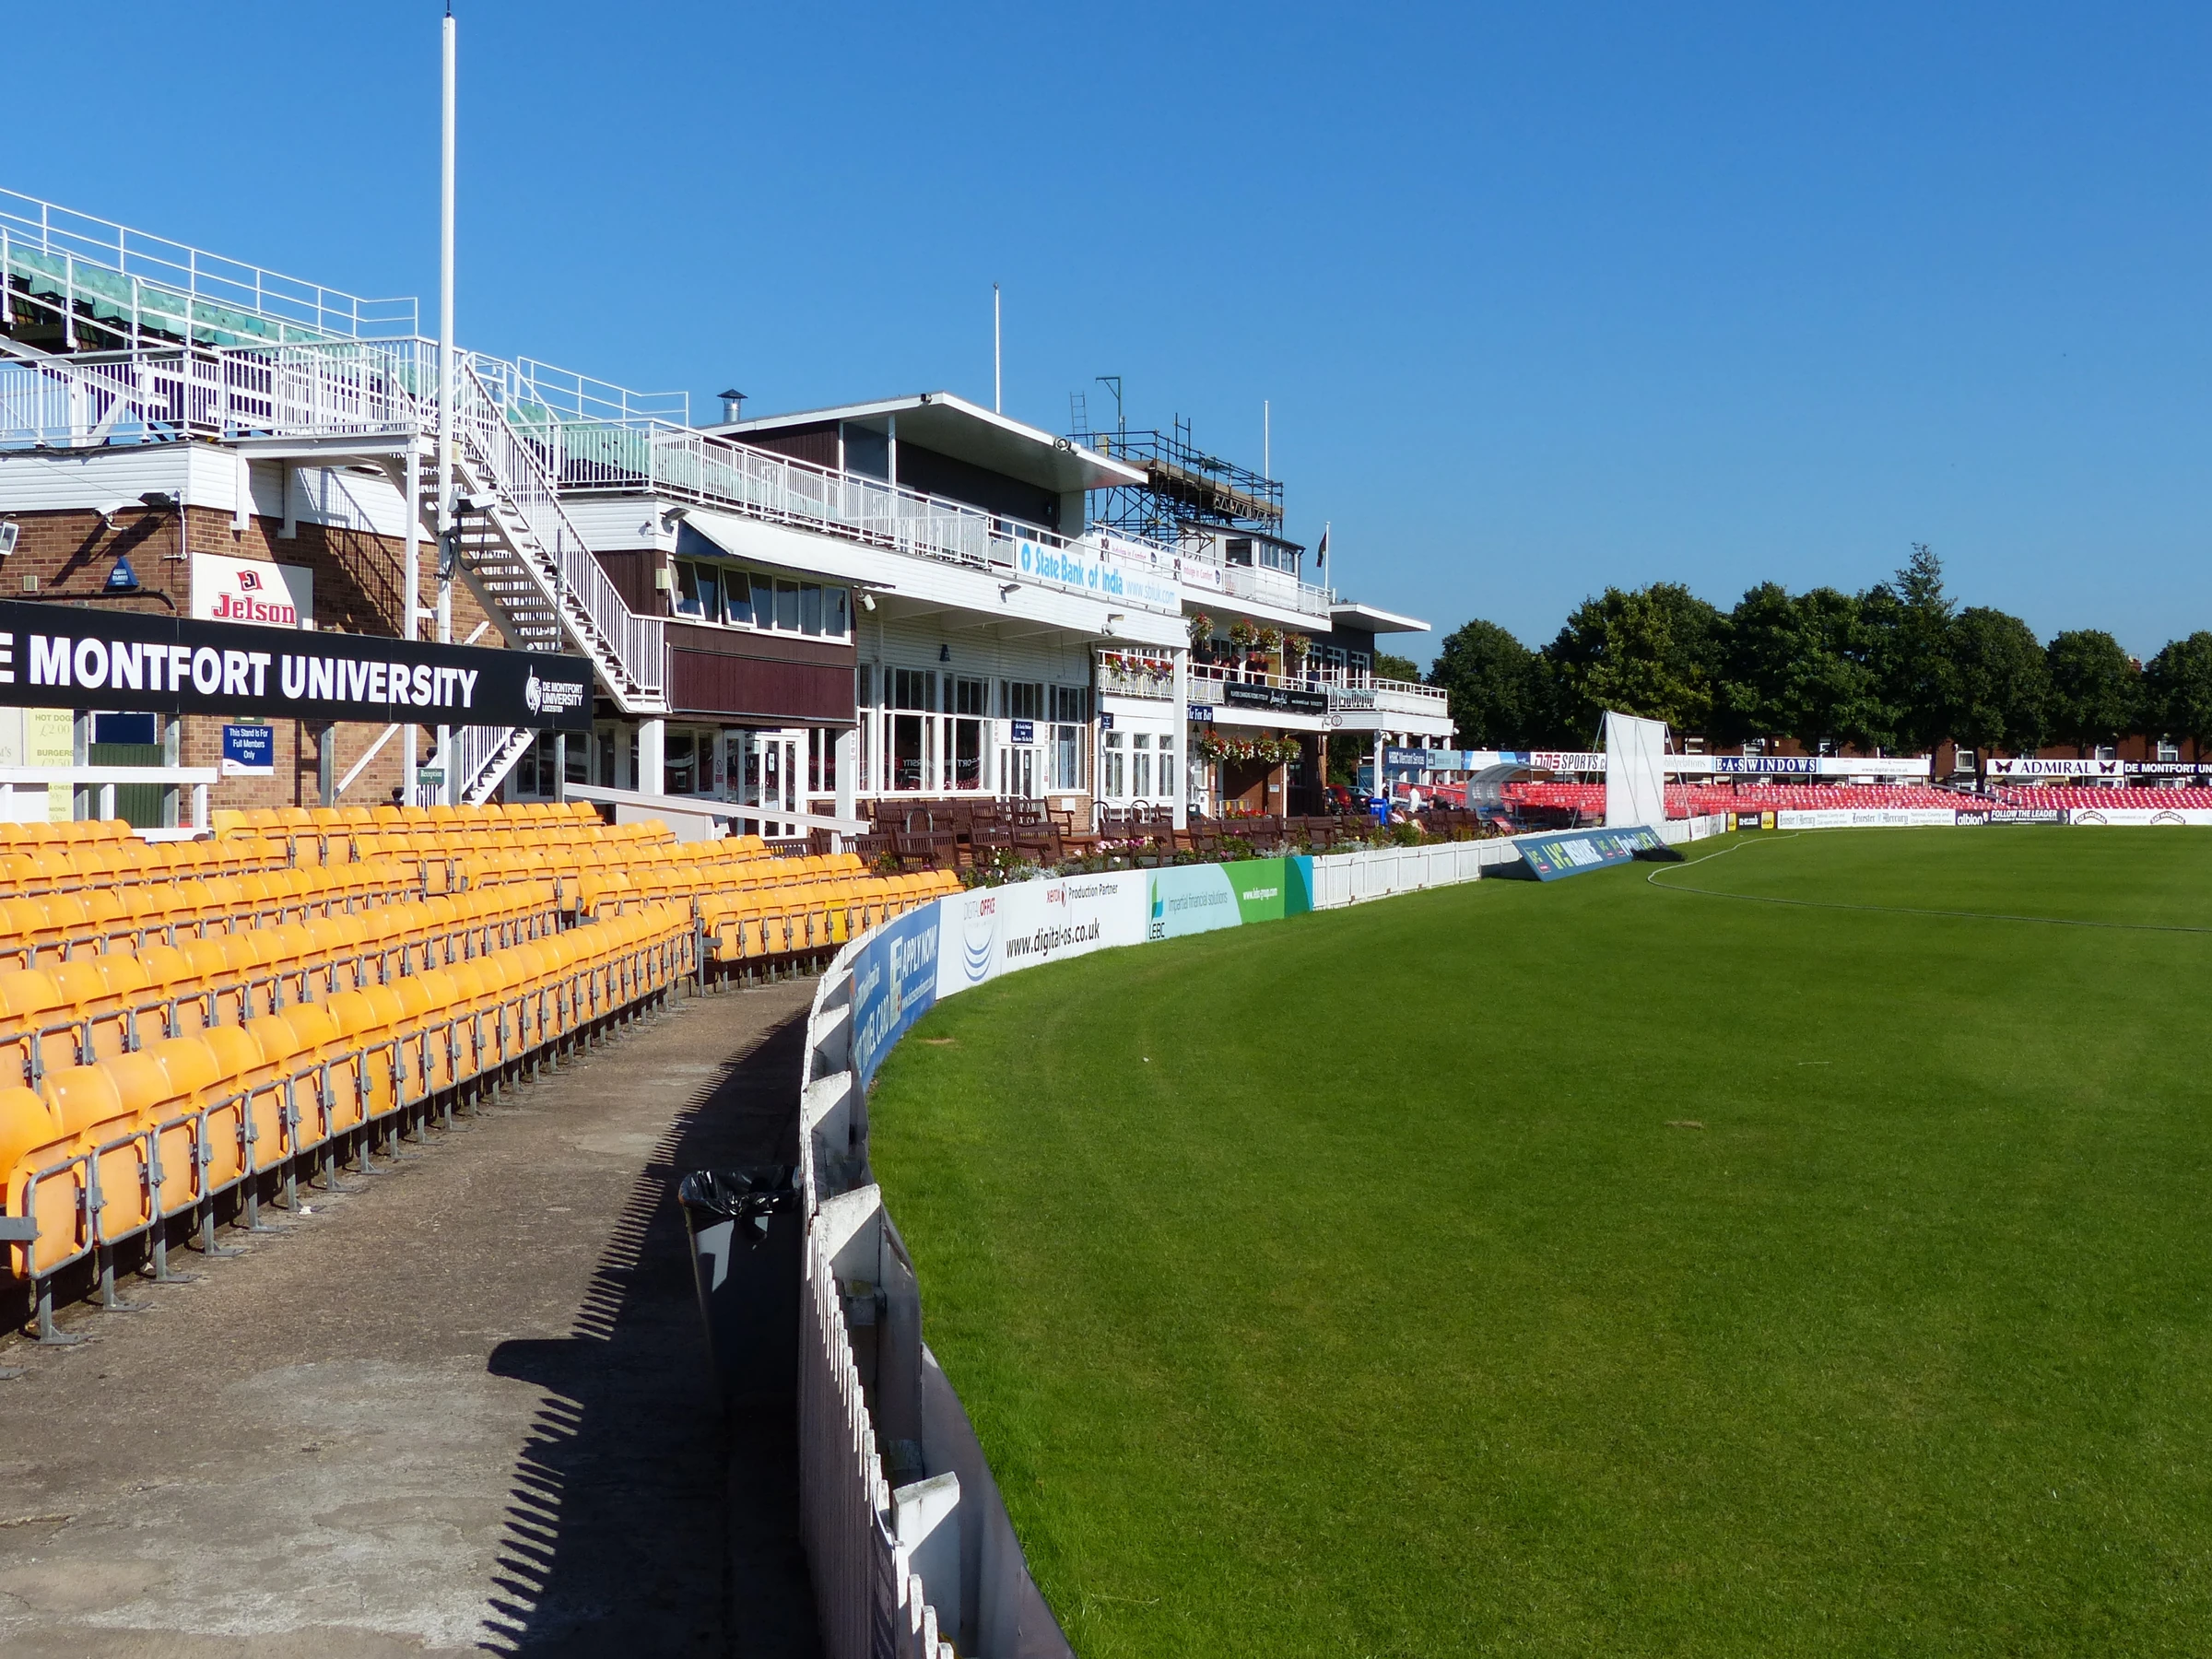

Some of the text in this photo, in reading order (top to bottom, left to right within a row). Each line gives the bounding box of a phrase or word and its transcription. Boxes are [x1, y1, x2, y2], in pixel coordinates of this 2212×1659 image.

[1035, 547, 1059, 580] State
[1062, 554, 1084, 586] Bank
[1088, 564, 1099, 590] of
[1102, 568, 1124, 595] India
[213, 594, 296, 624] Jelson
[29, 634, 271, 697] MONTFORT
[281, 654, 478, 708] UNIVERSITY
[542, 682, 583, 694] DE MONTFORT
[542, 692, 583, 706] UNIVERSITY
[53, 714, 74, 723] DOGS
[1203, 709, 1212, 721] Bar
[229, 728, 240, 736] This
[241, 728, 254, 737] Stand
[255, 729, 260, 737] Is
[232, 739, 265, 748] Full Members
[243, 750, 255, 760] Only
[1561, 753, 1606, 771] SPORTS.c
[1747, 759, 1816, 772] WINDOWS
[2020, 761, 2091, 774] ADMIRAL
[2124, 763, 2139, 773] DE
[2141, 763, 2195, 774] MONTFORT
[1853, 813, 1909, 825] Leicester Mercury
[1957, 813, 1983, 826] albion
[1991, 809, 2057, 818] FOLLOW THE LEADER
[1047, 883, 1118, 903] xerox Production Partner
[1169, 890, 1228, 915] Impartial financial solutions
[1006, 917, 1100, 959] www.digital-os.co.uk
[1148, 923, 1165, 940] LEBC
[901, 934, 922, 981] APPLY
